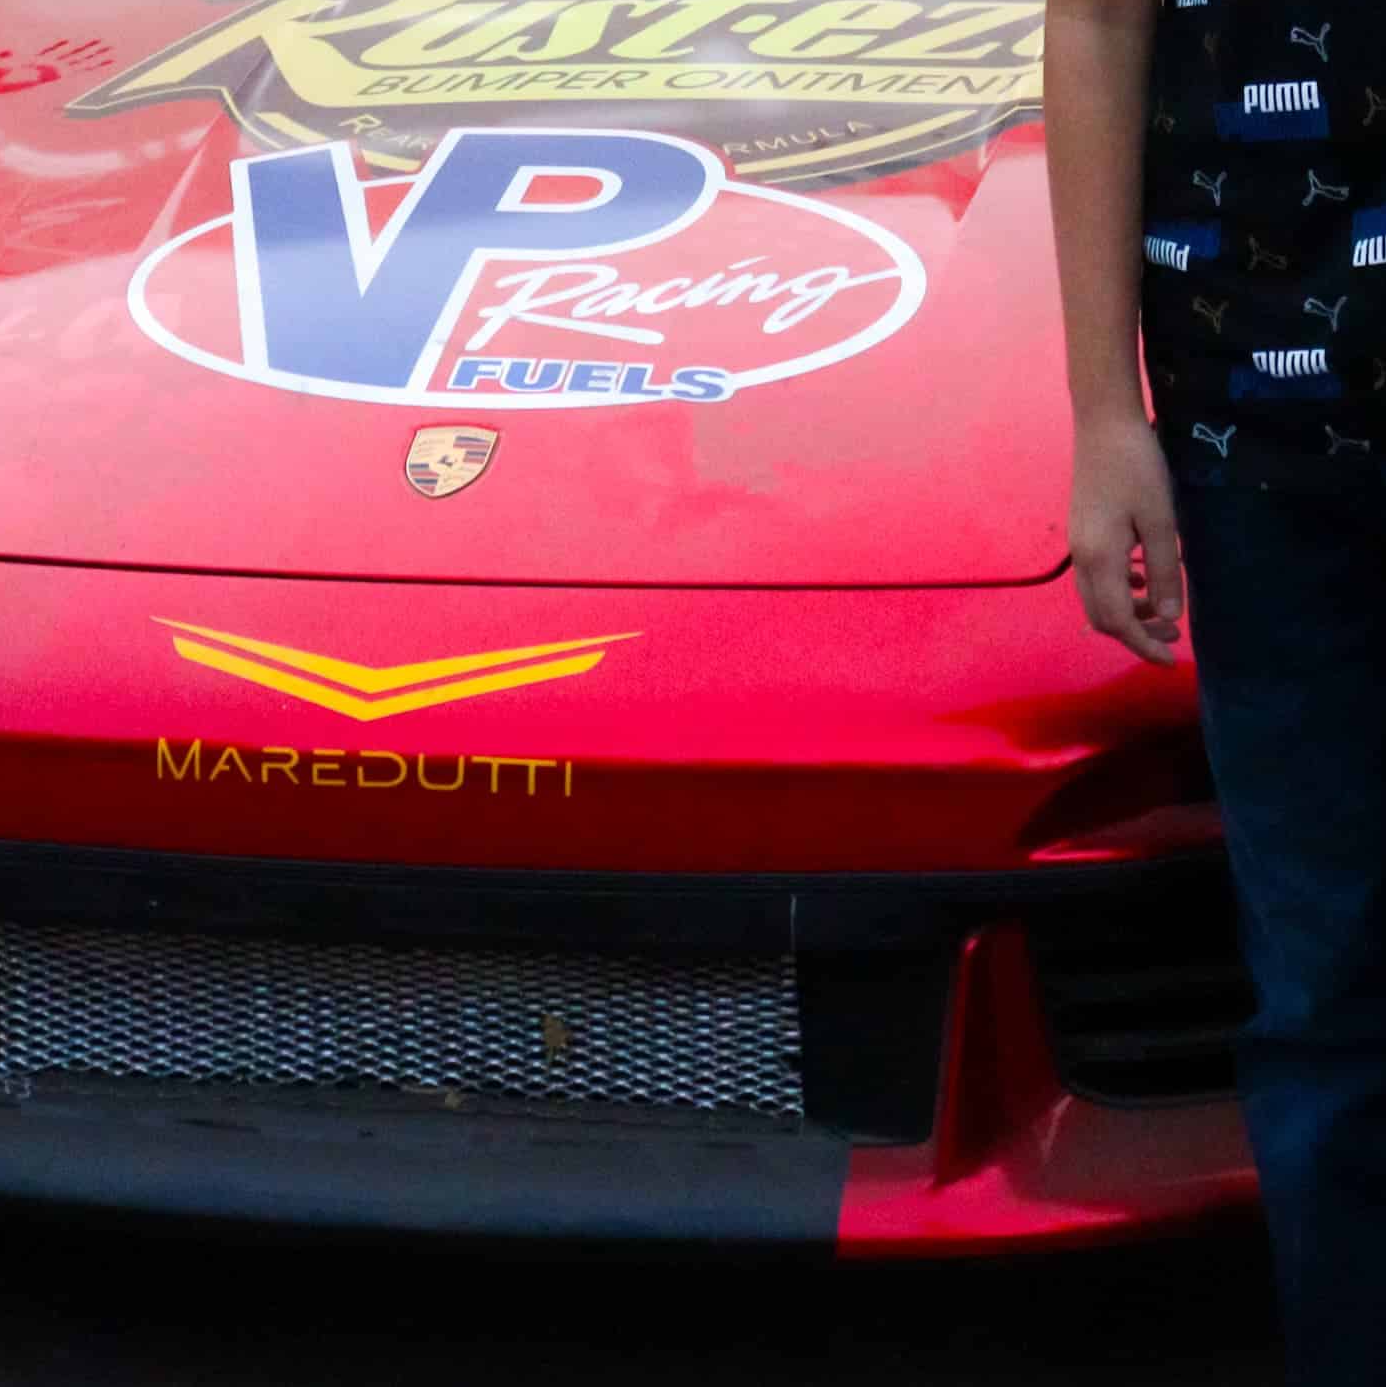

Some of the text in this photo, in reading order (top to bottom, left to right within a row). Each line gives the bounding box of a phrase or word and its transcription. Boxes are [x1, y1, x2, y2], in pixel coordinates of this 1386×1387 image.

[356, 68, 1039, 97] BUMPER OINTMENT
[1243, 80, 1320, 114] PUMA
[722, 119, 875, 157] RMULA
[230, 129, 731, 390] VP
[465, 255, 883, 350] Racing
[450, 358, 731, 402] FUELS
[1252, 348, 1327, 377] PUMA
[156, 735, 573, 798] MAREDUTTI
